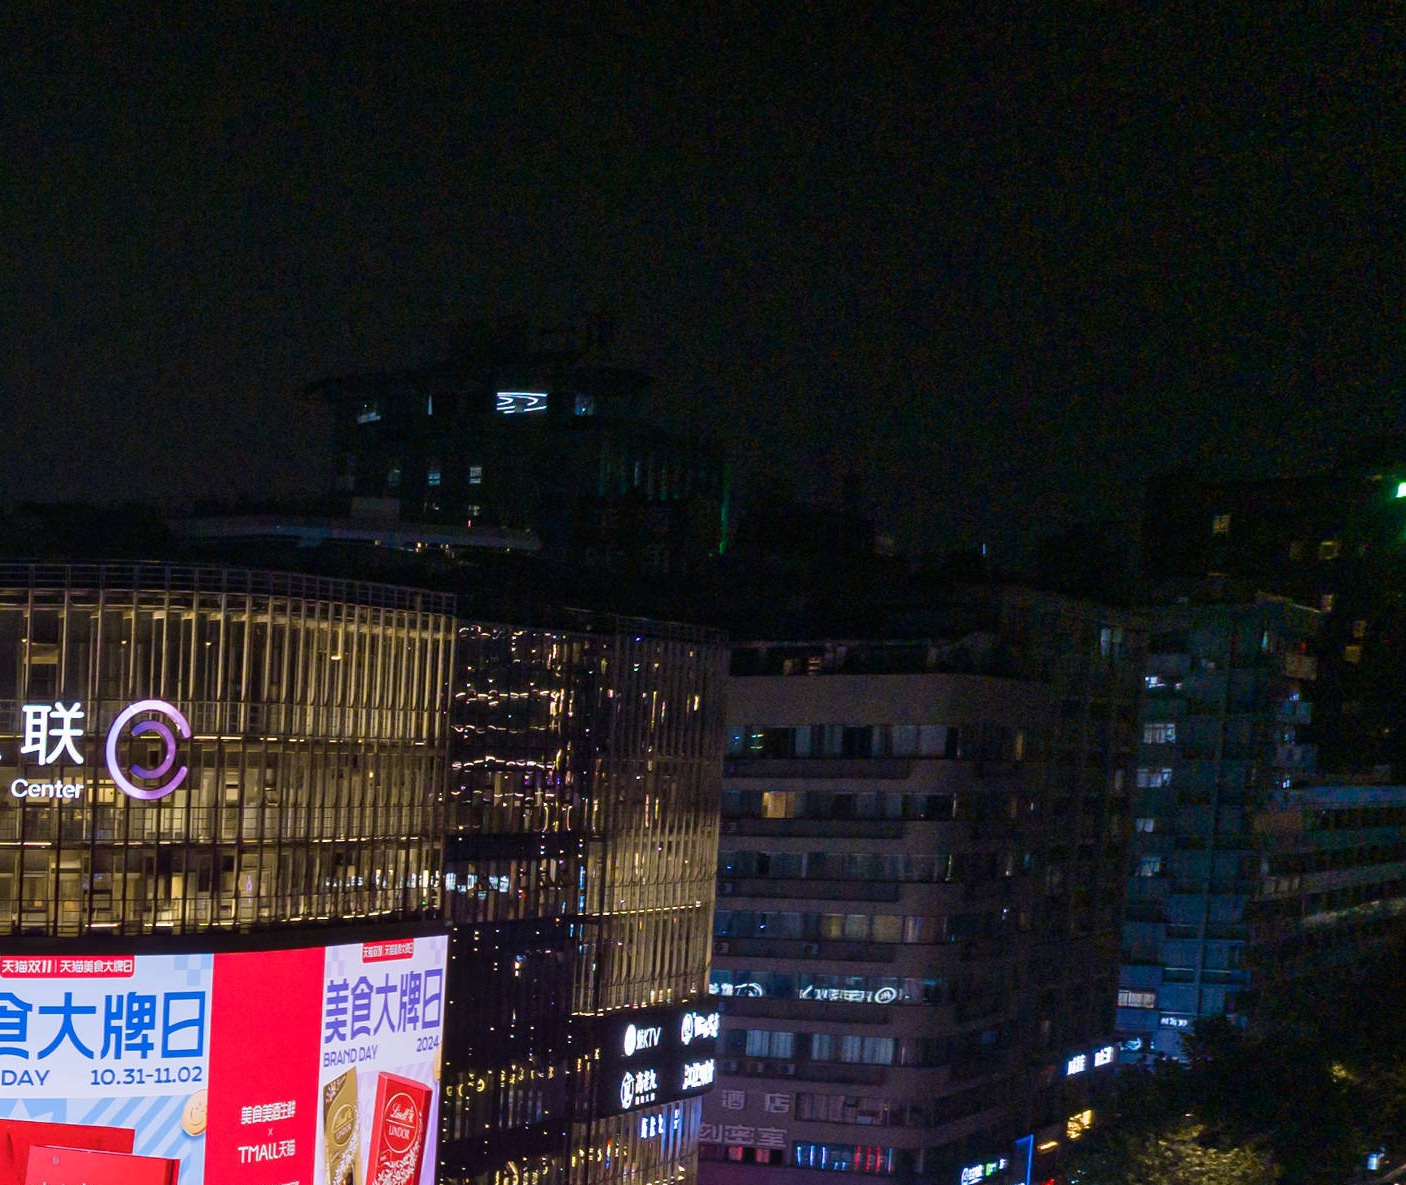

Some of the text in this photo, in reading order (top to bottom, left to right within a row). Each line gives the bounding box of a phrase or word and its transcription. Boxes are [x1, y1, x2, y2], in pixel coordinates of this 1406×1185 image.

[10, 777, 84, 799] Center
[60, 960, 133, 973] 天猫美食大牌日
[324, 968, 443, 1044] 美食大牌日
[416, 1035, 439, 1052] 2024
[324, 1045, 378, 1067] BRAND DAY
[1, 1069, 50, 1086] DAY
[91, 1066, 203, 1086] 10.31-11.02
[721, 1089, 790, 1113] 酒店
[241, 1100, 296, 1125] 美食美酒生鲜
[388, 1124, 411, 1140] LINDOR
